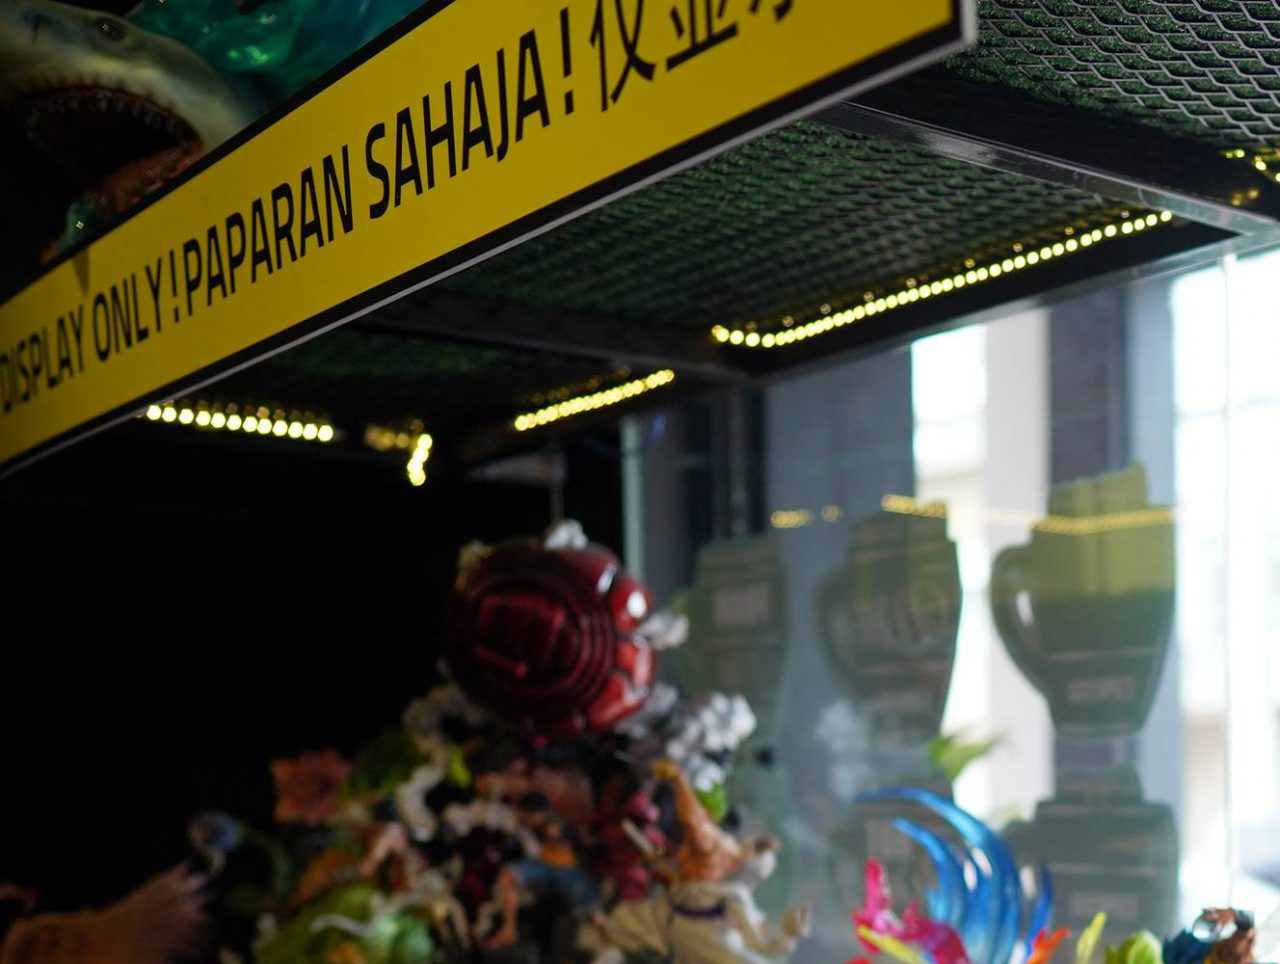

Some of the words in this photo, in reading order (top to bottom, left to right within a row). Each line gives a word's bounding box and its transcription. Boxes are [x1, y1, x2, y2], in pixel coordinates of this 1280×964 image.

[92, 250, 180, 363] ONLY!
[183, 144, 354, 317] PAPARAN
[365, 6, 574, 219] SAHAJA!
